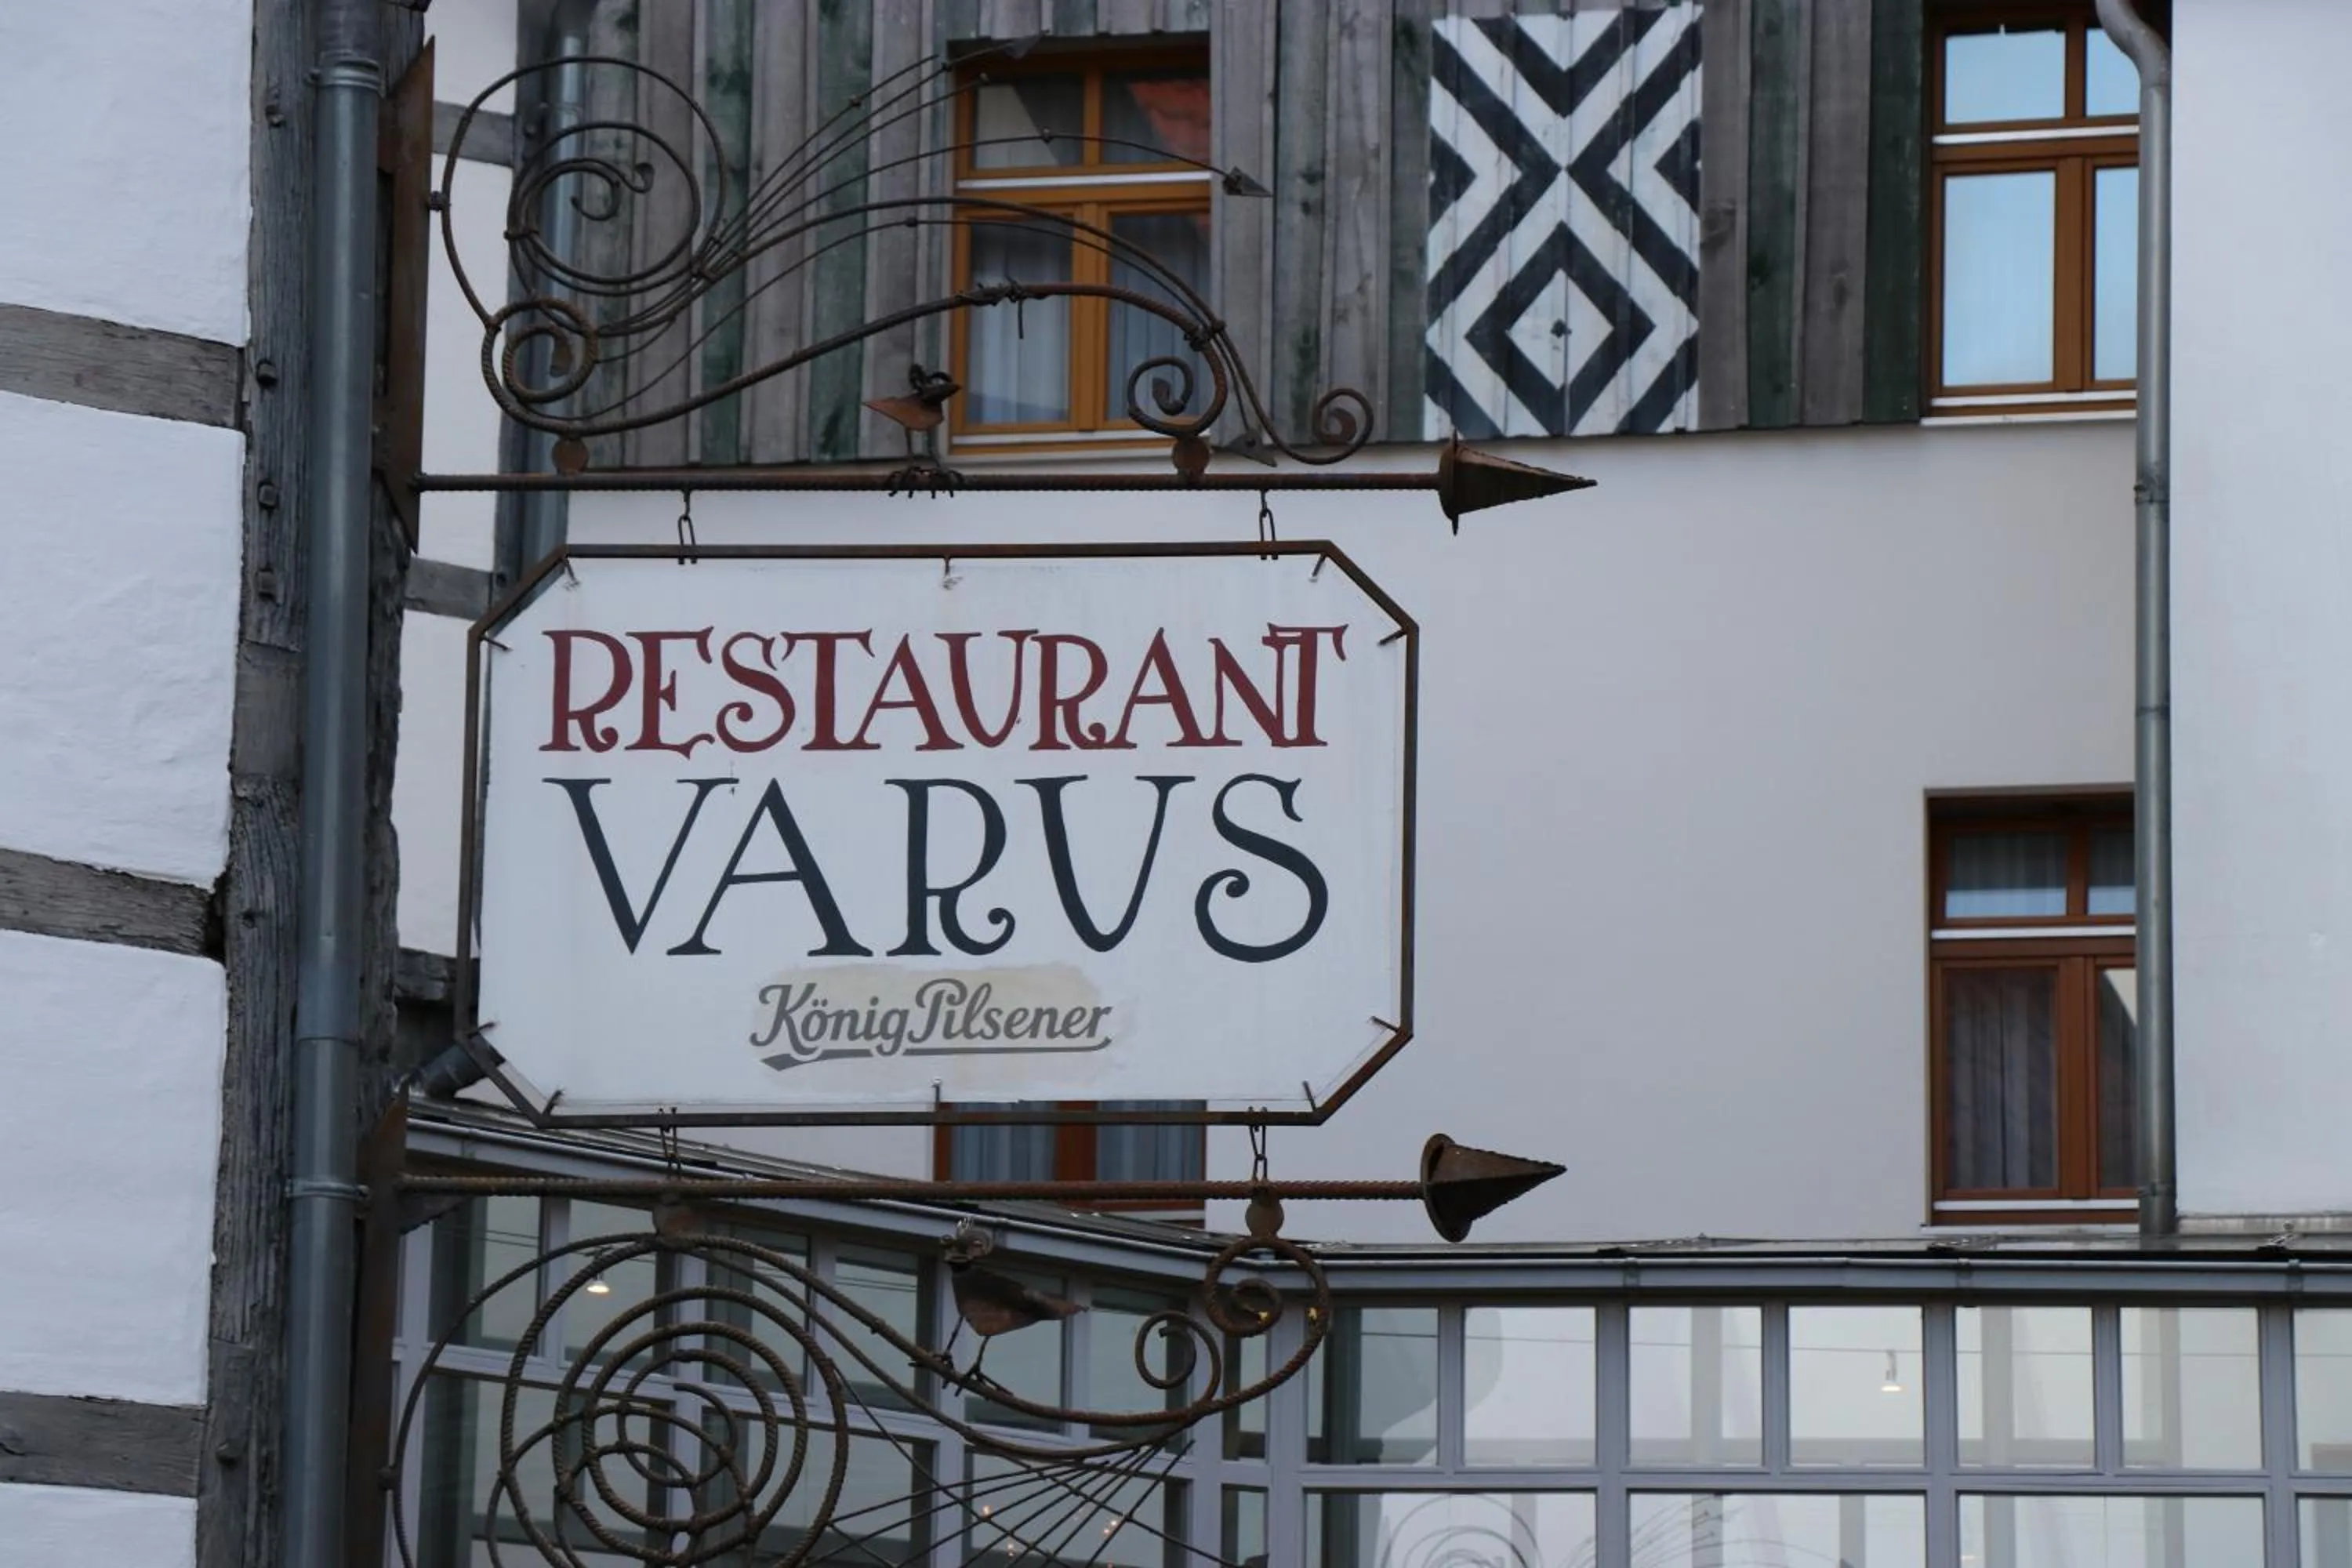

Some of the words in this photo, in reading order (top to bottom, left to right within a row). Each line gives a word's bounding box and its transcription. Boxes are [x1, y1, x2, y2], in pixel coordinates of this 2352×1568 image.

[539, 623, 1347, 758] RESTAURANT
[543, 774, 1328, 963] VARUS
[750, 982, 910, 1056] König
[907, 978, 1113, 1044] Pilsener
